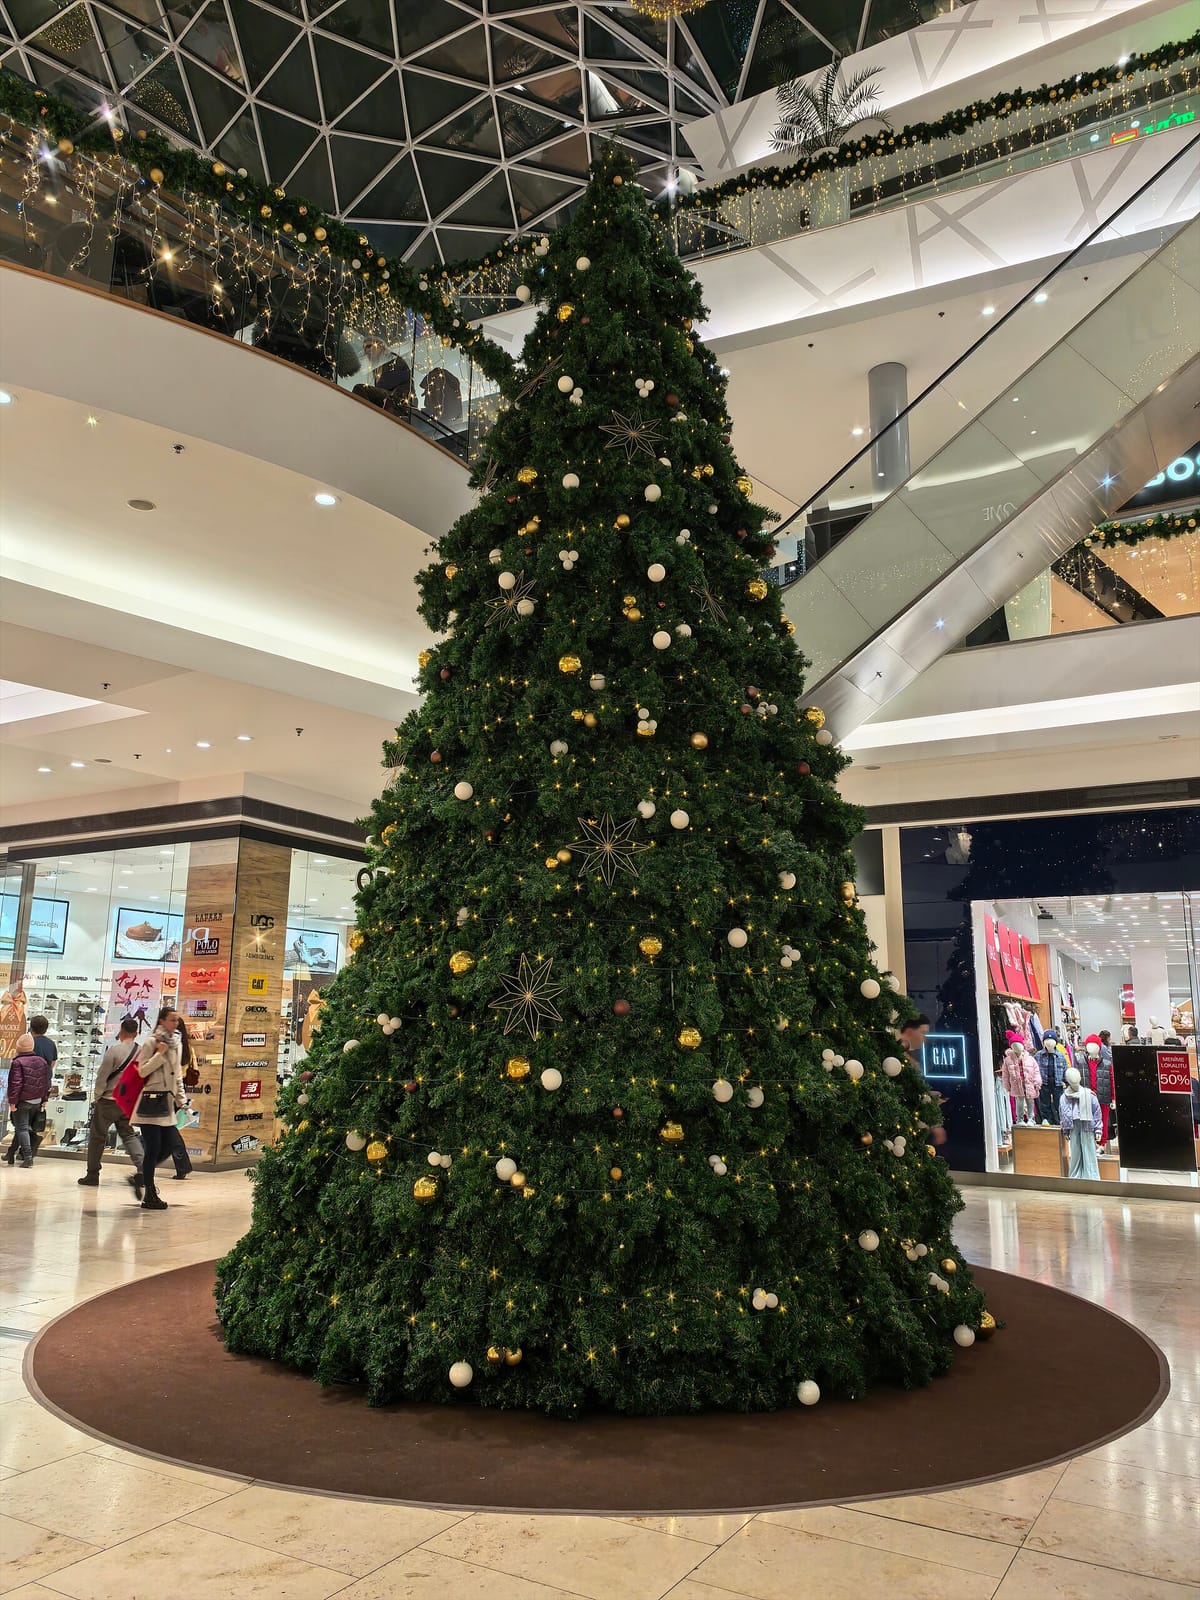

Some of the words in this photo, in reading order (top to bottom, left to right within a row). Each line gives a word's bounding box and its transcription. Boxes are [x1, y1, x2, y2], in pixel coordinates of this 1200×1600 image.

[196, 939, 218, 950] POLO
[251, 979, 264, 990] CAT
[245, 1005, 268, 1013] GEOX
[932, 1047, 956, 1066] GAP
[235, 1060, 269, 1068] SKECHERS
[1160, 1073, 1190, 1085] 50%
[234, 1112, 263, 1122] CONVERSE
